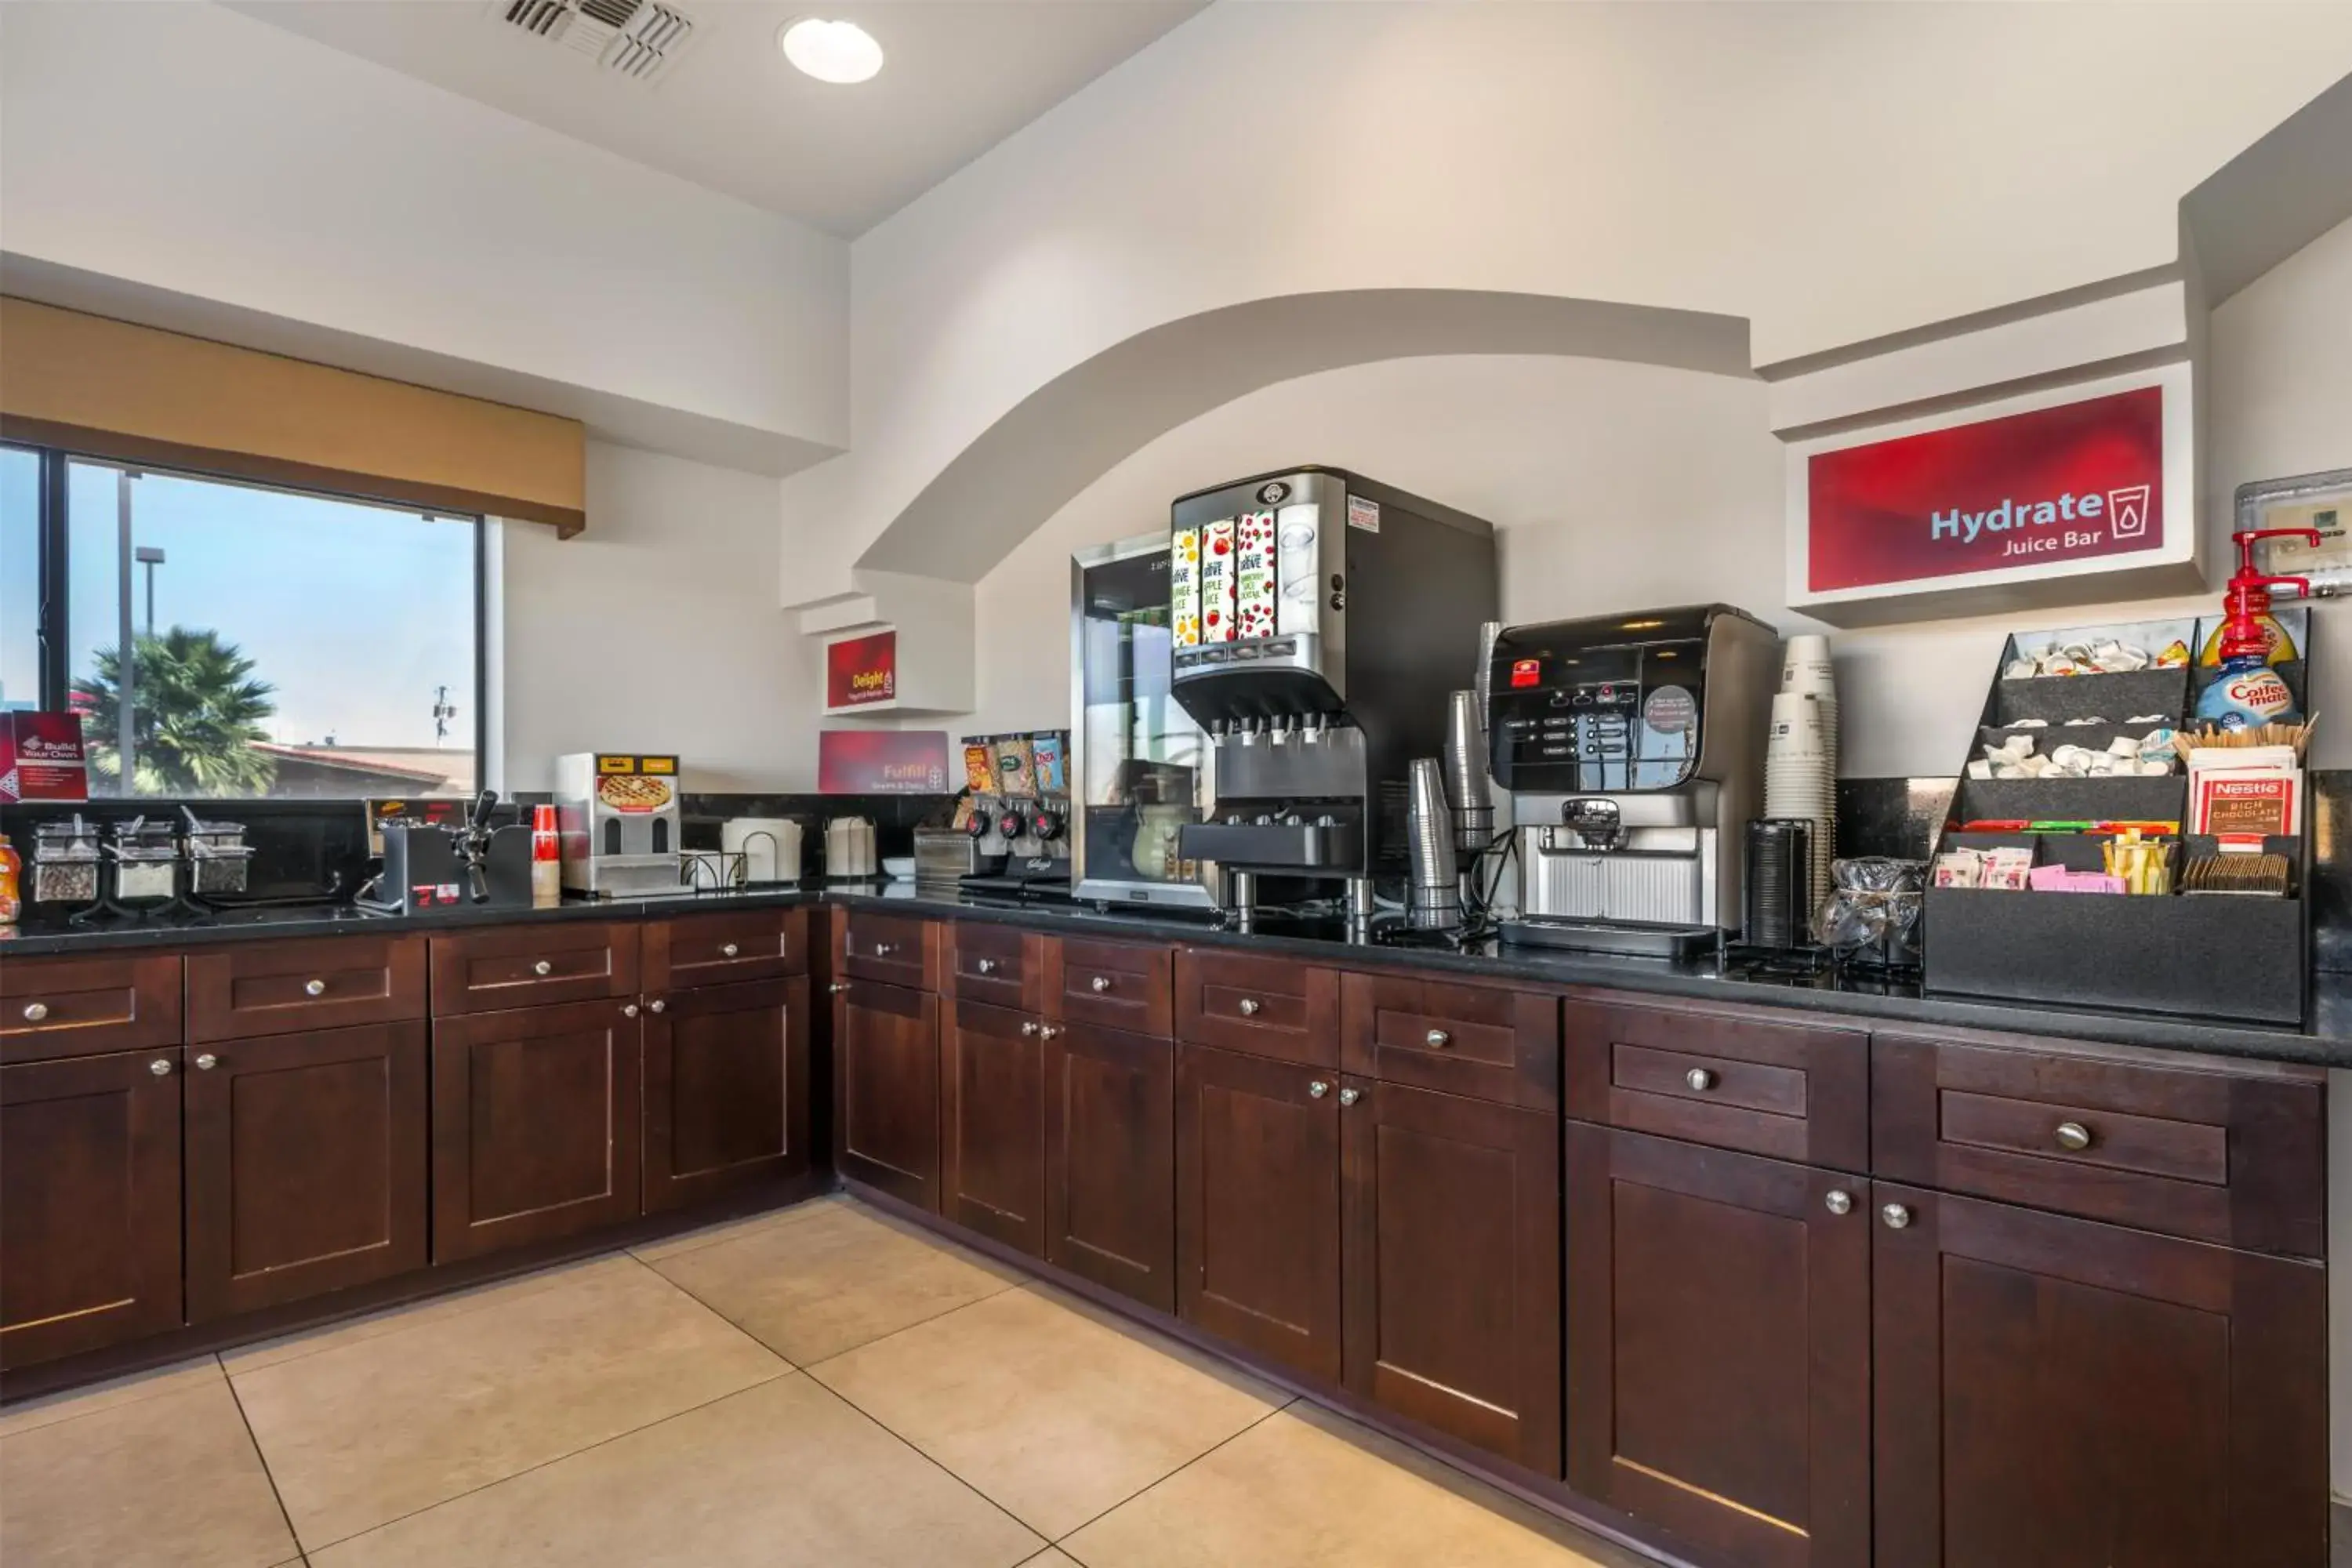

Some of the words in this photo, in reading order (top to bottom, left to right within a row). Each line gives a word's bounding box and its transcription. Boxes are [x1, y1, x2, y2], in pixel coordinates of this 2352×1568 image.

[1931, 492, 2103, 543] Hydrate
[2002, 535, 2058, 557] Juice
[2064, 530, 2102, 548] Bar
[852, 671, 884, 690] Delight
[2231, 684, 2285, 700] Coffee
[2250, 693, 2287, 707] mate
[23, 749, 48, 757] Your
[51, 750, 78, 759] Own
[45, 742, 76, 751] Build
[884, 764, 927, 779] Fulfill
